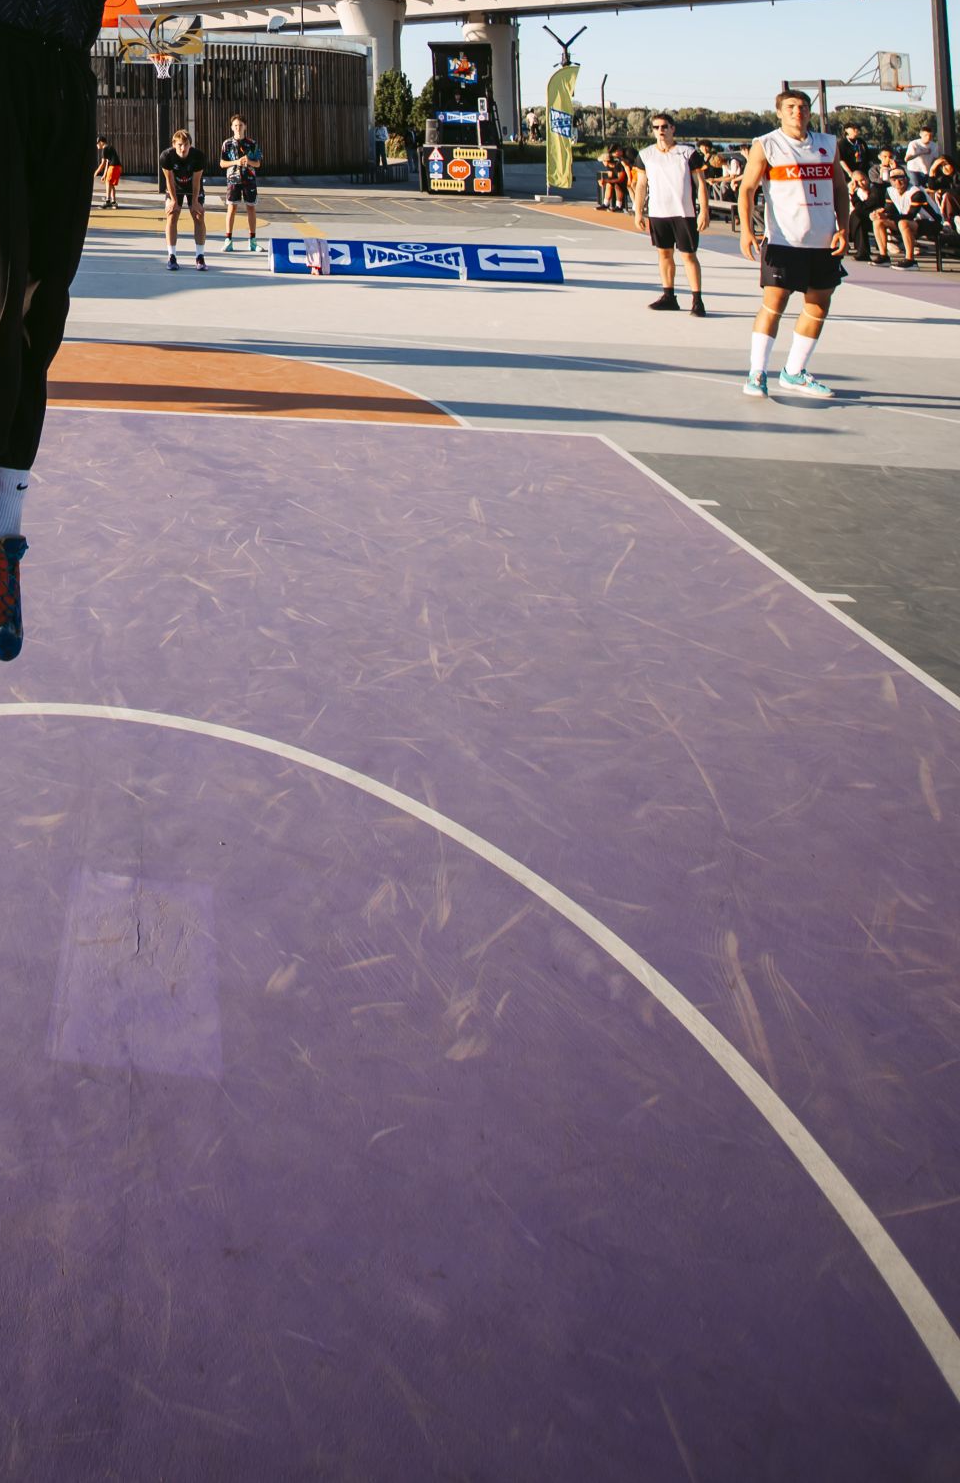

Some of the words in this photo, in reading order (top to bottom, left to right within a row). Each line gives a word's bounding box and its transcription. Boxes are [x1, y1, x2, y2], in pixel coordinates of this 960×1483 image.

[452, 165, 467, 174] SPOT
[785, 166, 831, 179] KAREX
[809, 183, 817, 197] 4
[367, 248, 410, 263] УРАМ
[419, 252, 460, 267] ФЕСТ
